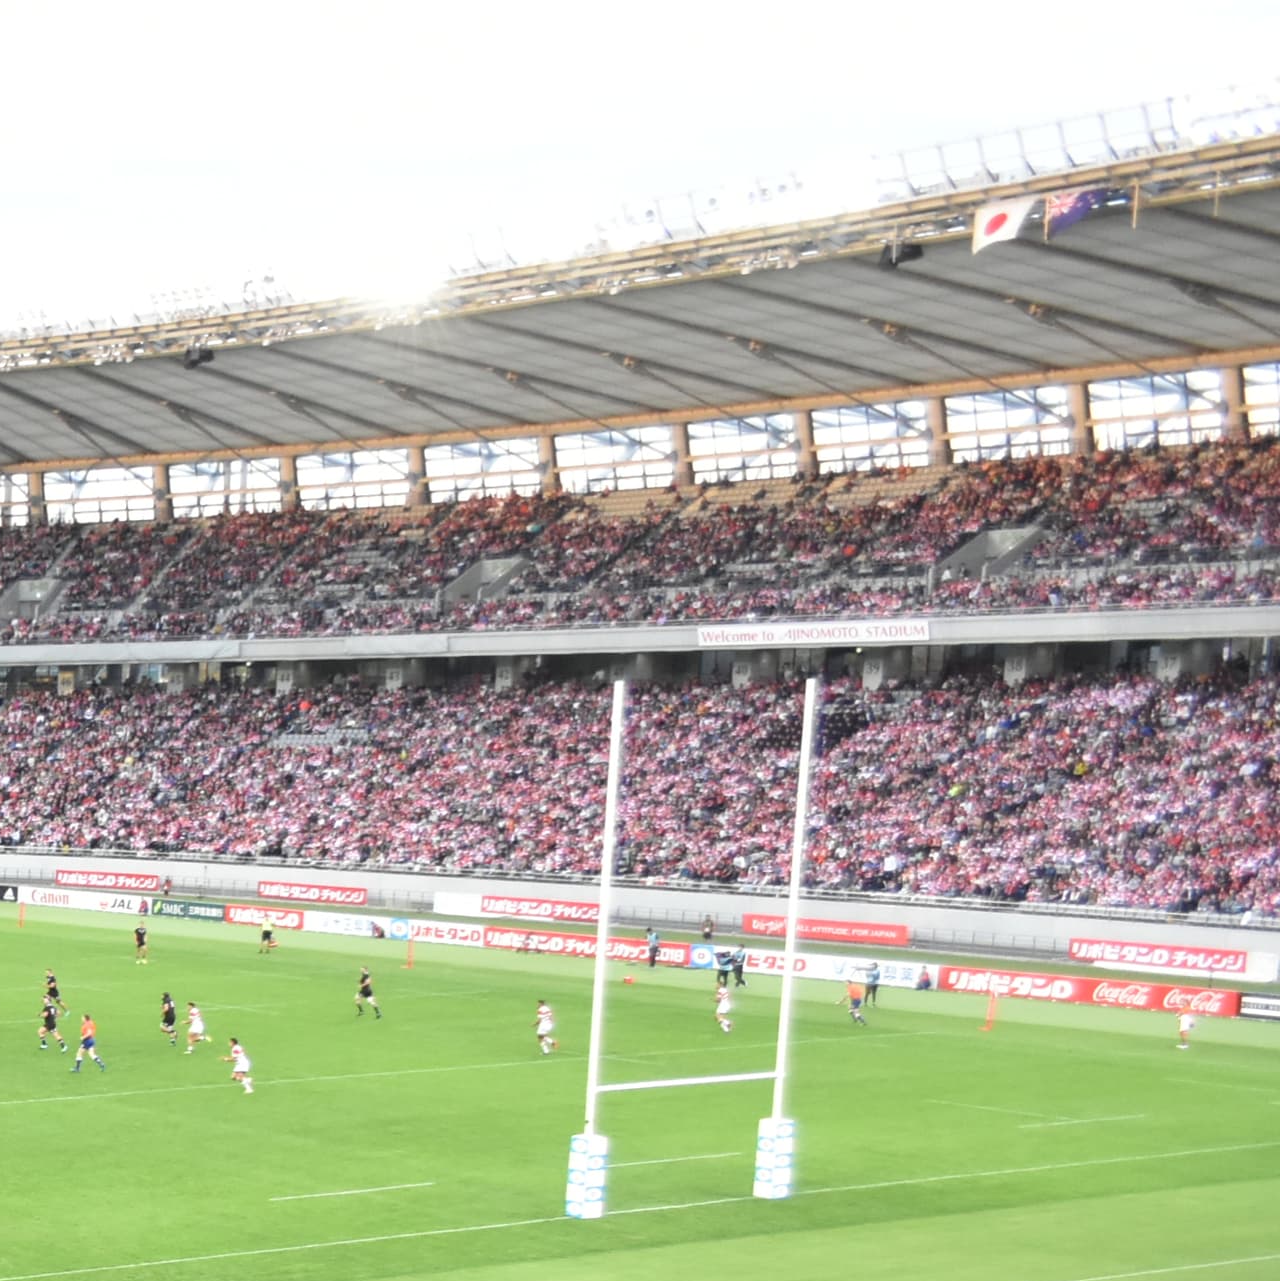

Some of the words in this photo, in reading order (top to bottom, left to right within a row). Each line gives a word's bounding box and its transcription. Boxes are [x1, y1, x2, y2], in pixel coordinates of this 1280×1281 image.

[702, 631, 758, 643] Welcome
[762, 631, 774, 641] to
[785, 627, 859, 641] AJINOMOTO
[865, 626, 925, 638] STADIUM
[57, 872, 116, 886] リポビタンD
[117, 876, 158, 889] チャレンジ
[32, 889, 69, 905] Canon
[259, 883, 319, 899] リポビタンD
[320, 888, 365, 903] チャレンジ
[110, 898, 133, 910] JAL
[162, 903, 184, 914] SMBC
[483, 897, 552, 917] リポビタンD
[411, 924, 481, 942] リポビタンD
[1072, 941, 1169, 965] リポビタンD
[1171, 951, 1244, 971] チャレンジ
[949, 971, 1073, 999] リポビタンD
